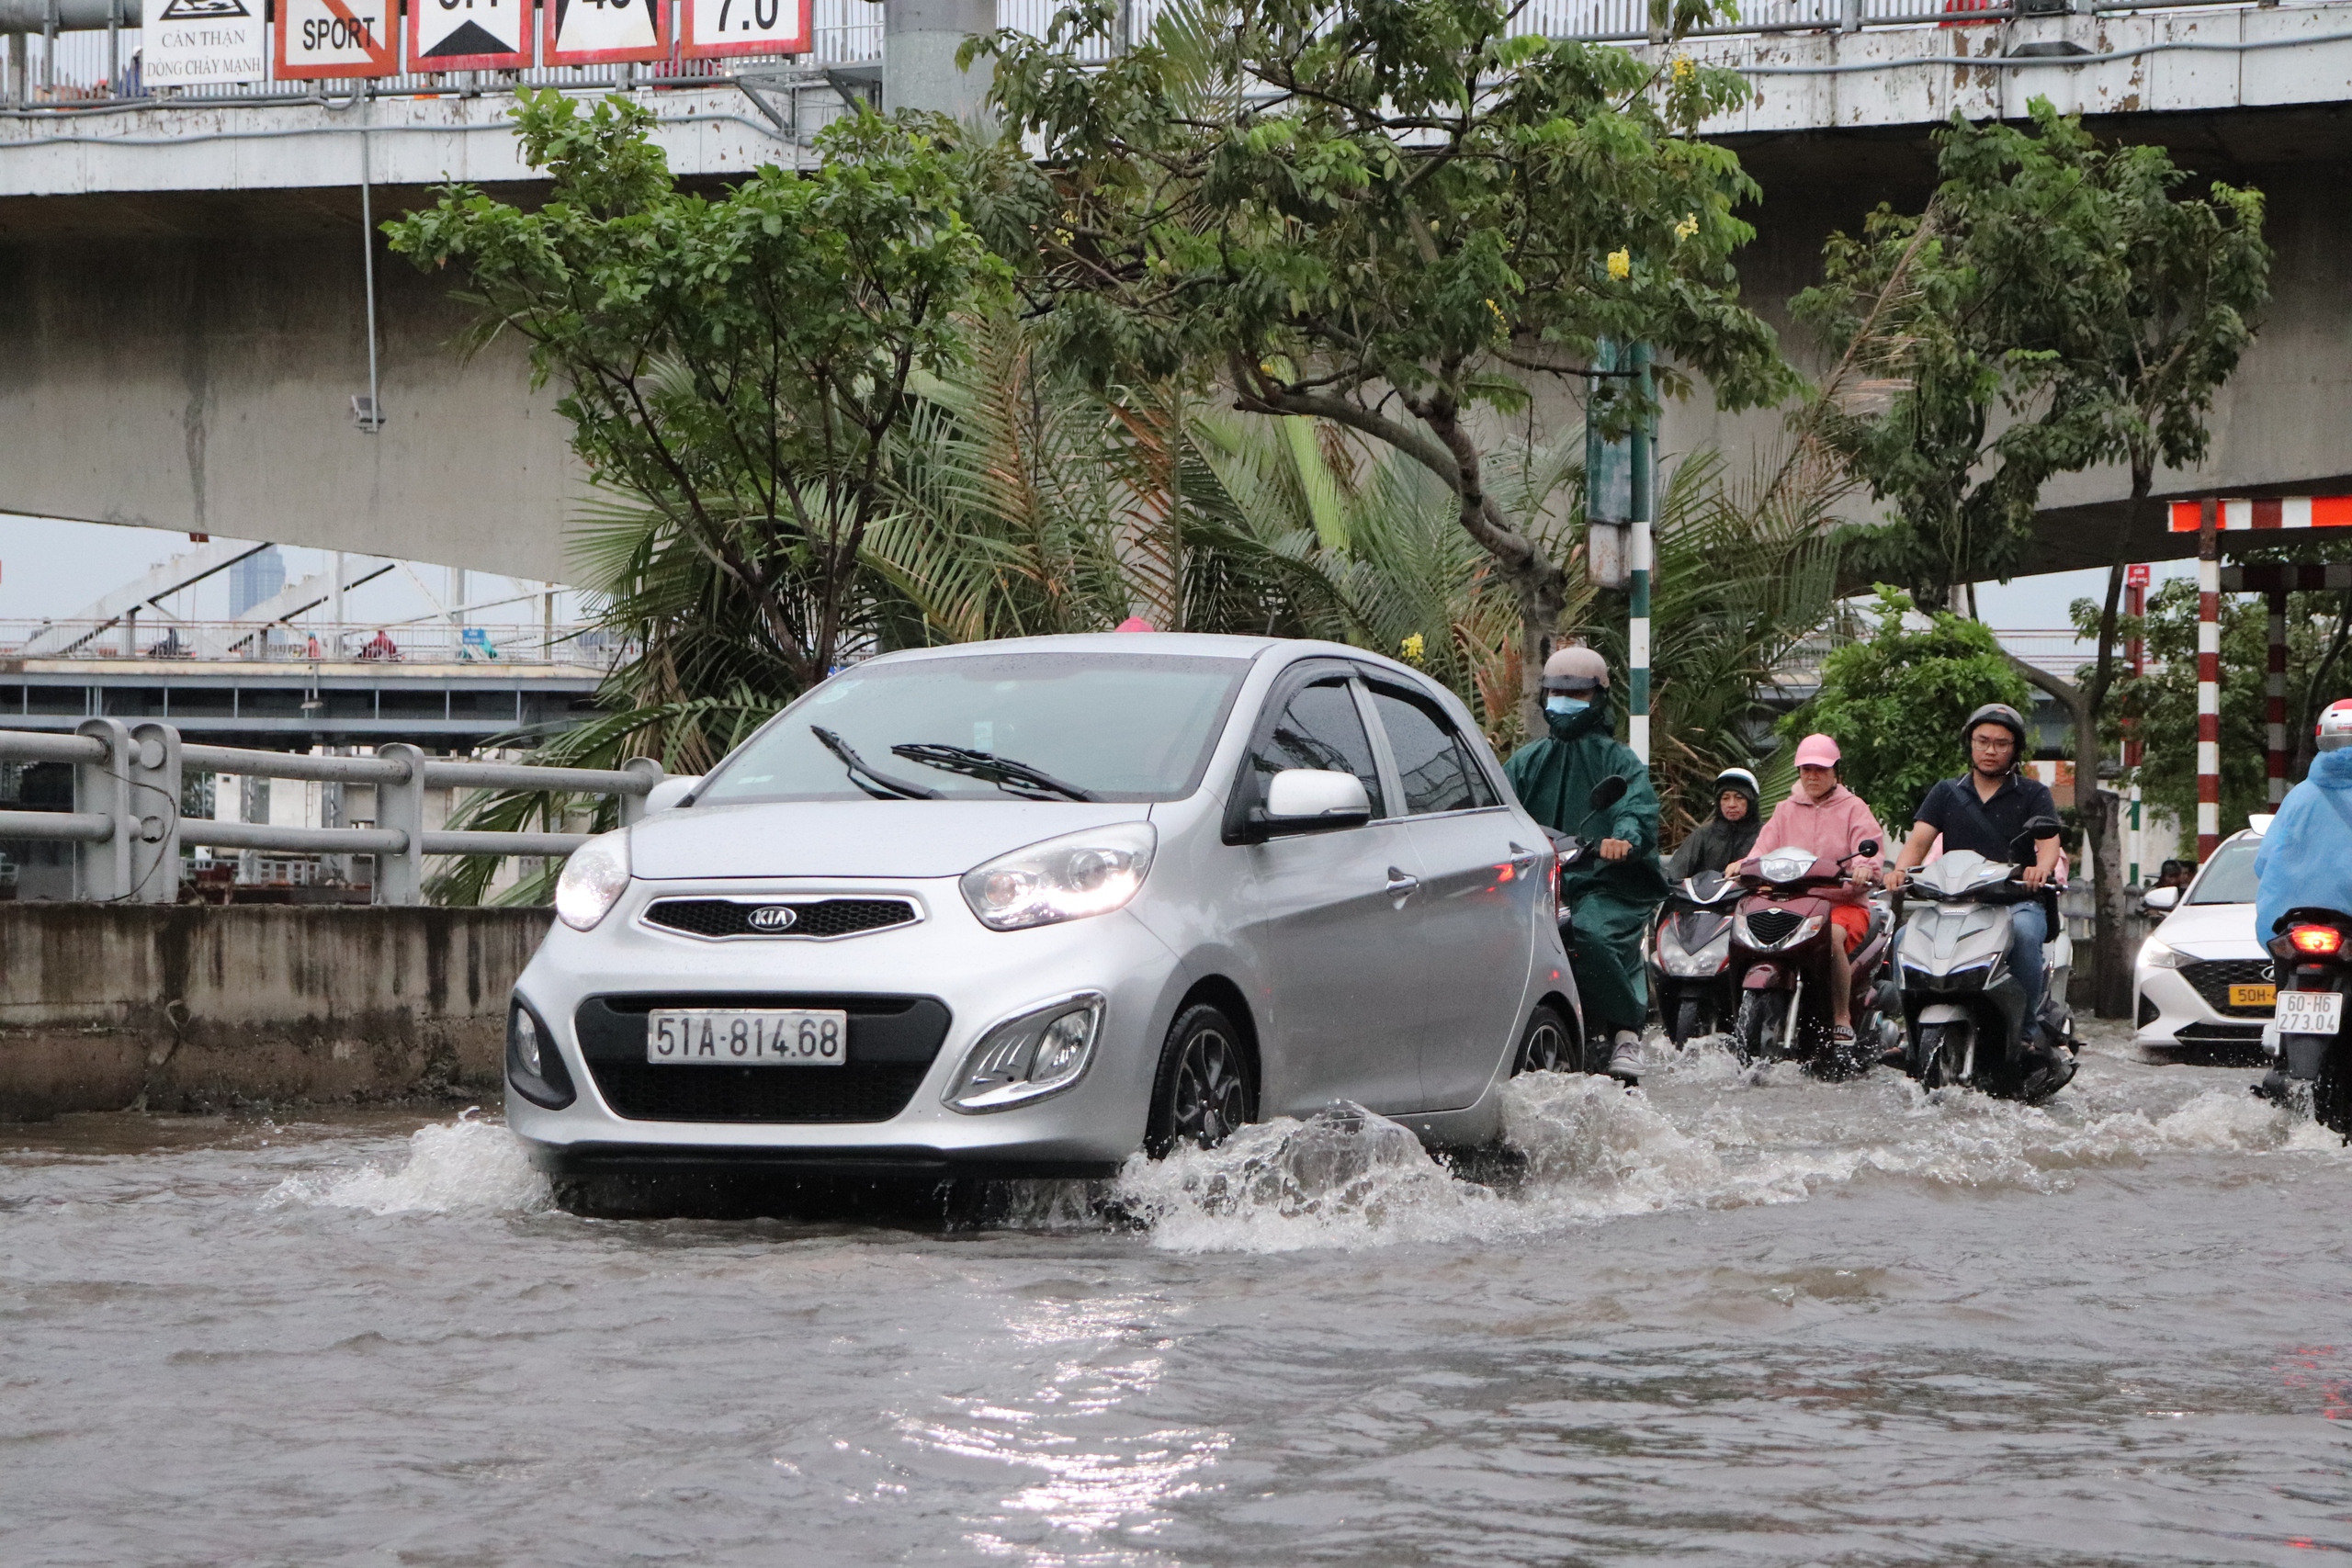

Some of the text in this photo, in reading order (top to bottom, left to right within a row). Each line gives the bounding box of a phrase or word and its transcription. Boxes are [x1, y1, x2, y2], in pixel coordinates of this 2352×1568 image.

[302, 17, 376, 51] SPORT
[222, 57, 261, 75] MẠNH
[754, 910, 787, 926] KIA
[2287, 995, 2331, 1012] 60-H6
[2278, 1013, 2335, 1031] 273.04
[657, 1017, 839, 1057] 51A-814.68
